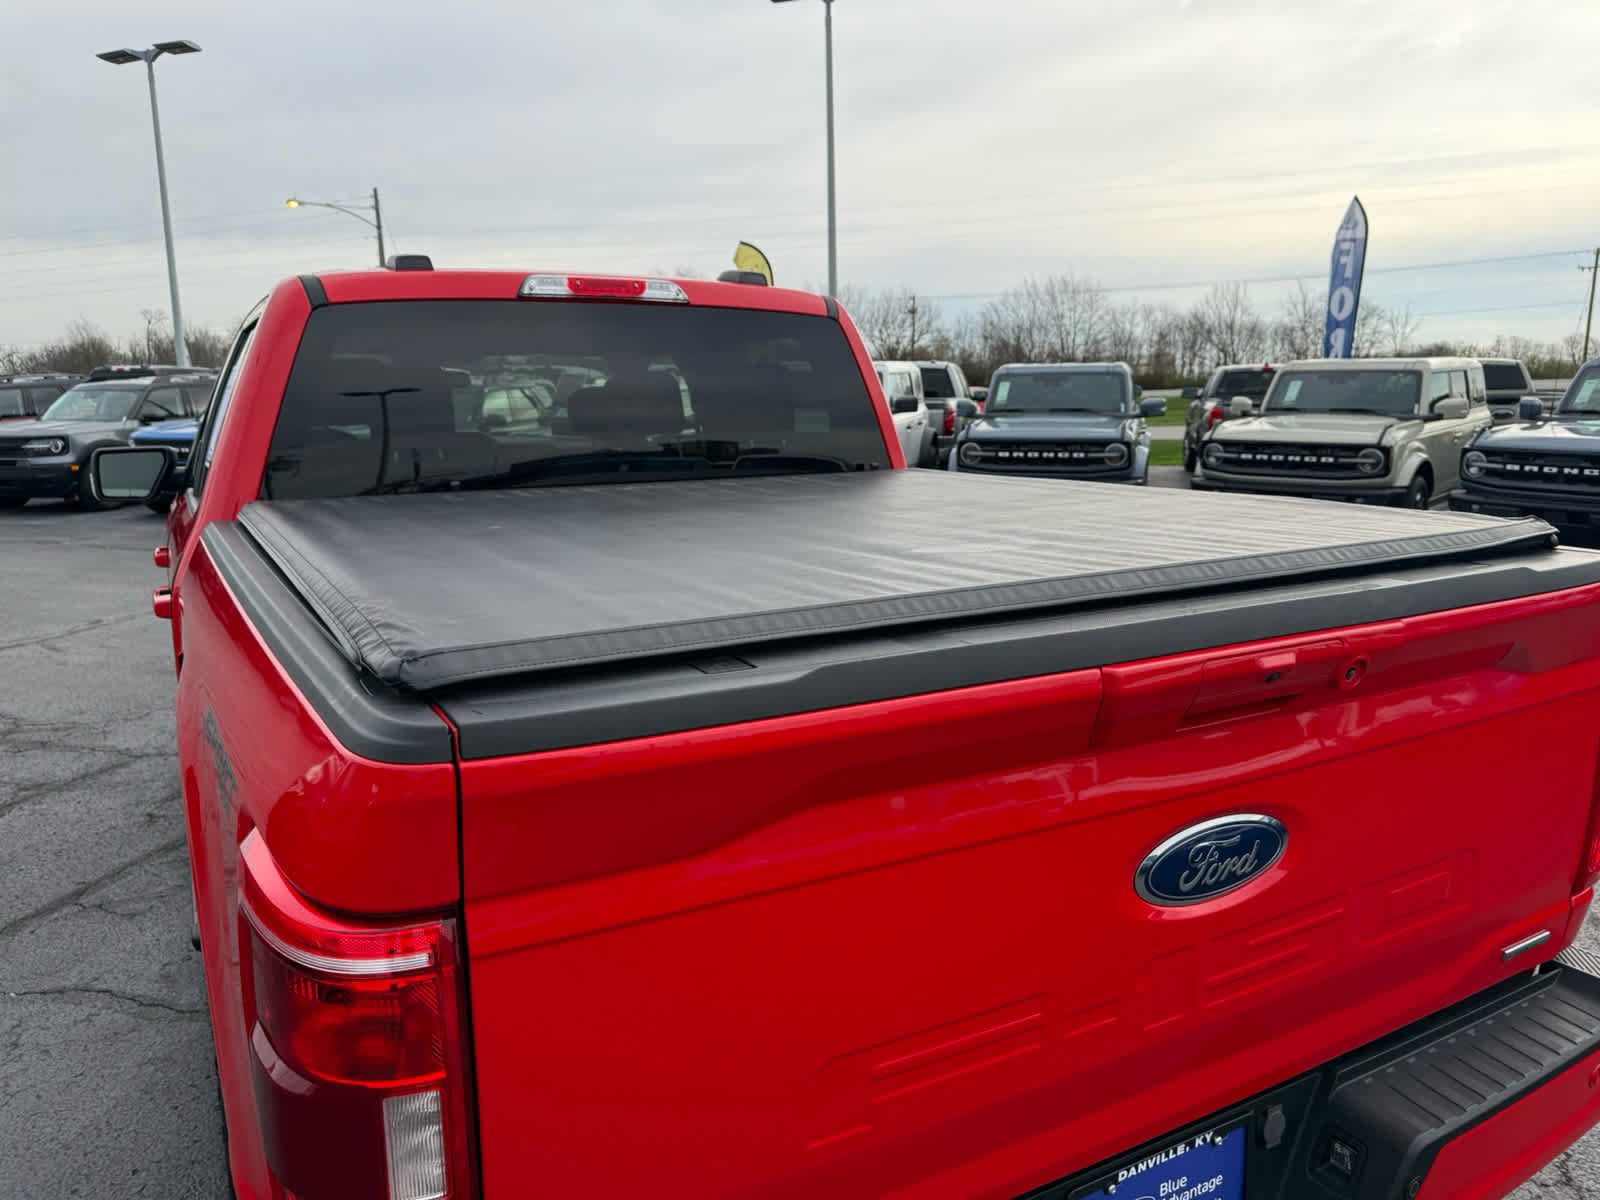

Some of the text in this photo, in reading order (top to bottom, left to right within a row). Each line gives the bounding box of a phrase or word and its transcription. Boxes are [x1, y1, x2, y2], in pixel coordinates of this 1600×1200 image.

[1240, 453, 1334, 463] BRONCO
[1178, 834, 1261, 893] Ford
[1117, 1131, 1213, 1182] DANVILLE, KY
[1159, 1176, 1188, 1197] Blue
[1161, 1174, 1223, 1200] dvantage
